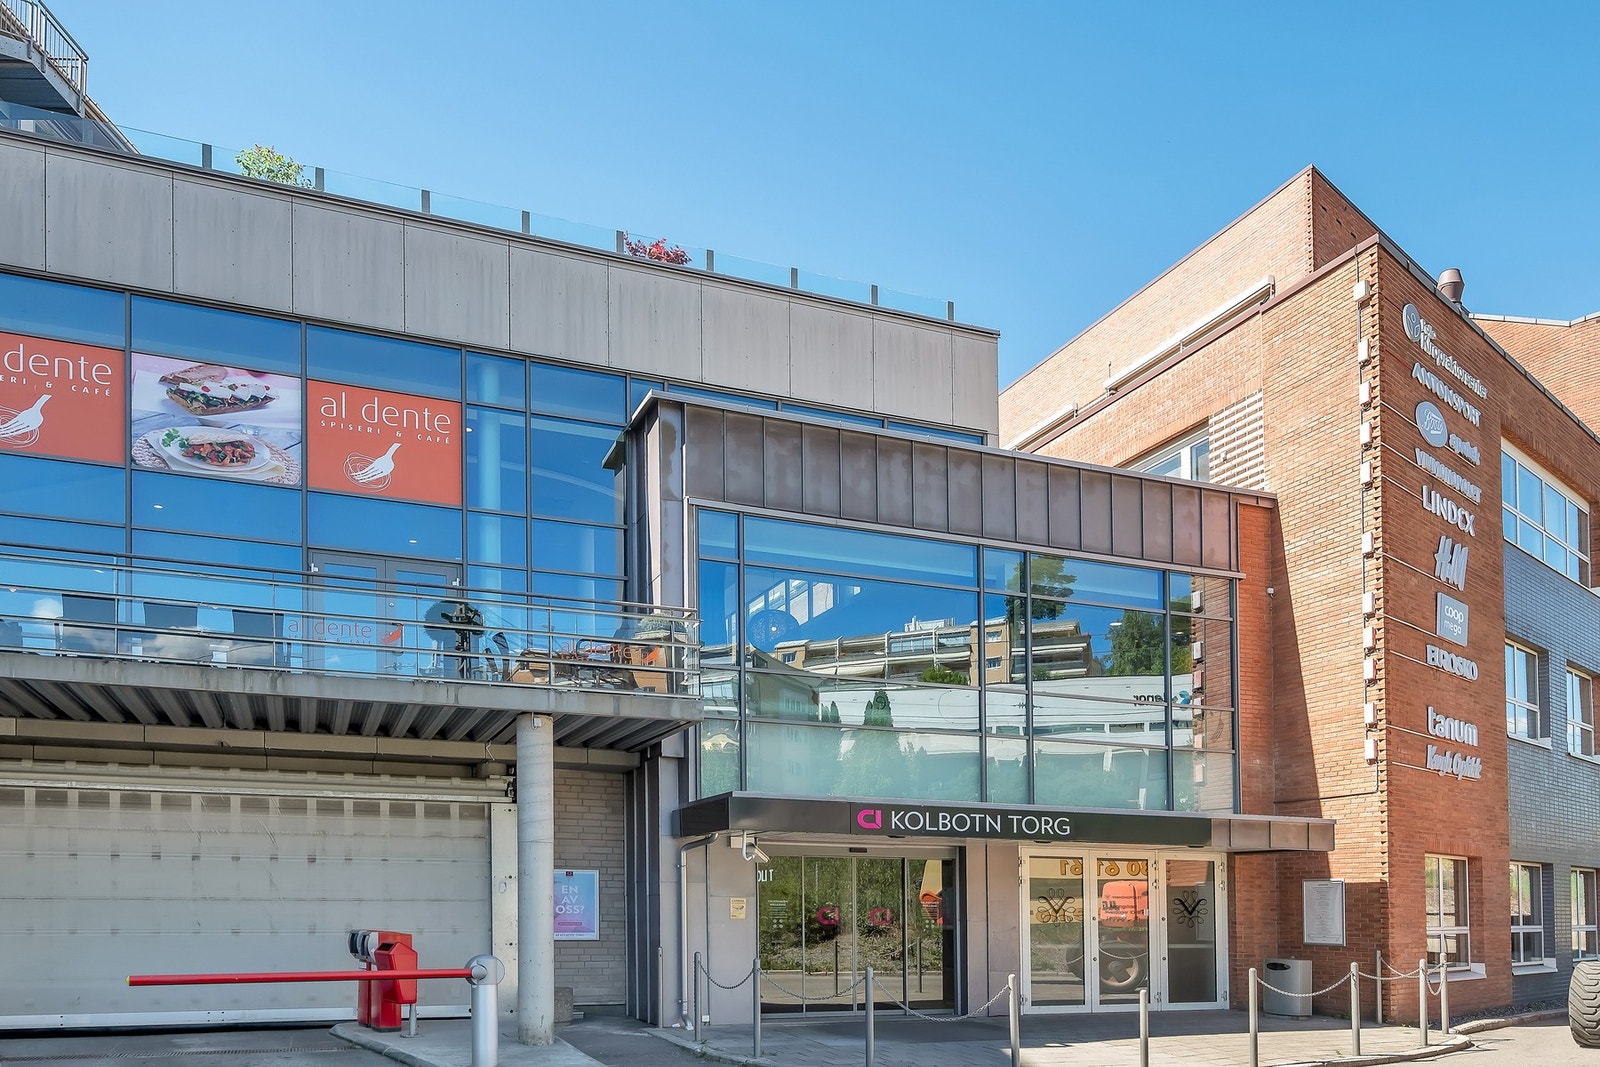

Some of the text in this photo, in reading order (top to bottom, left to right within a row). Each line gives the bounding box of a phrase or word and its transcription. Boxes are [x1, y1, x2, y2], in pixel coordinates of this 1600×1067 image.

[3, 343, 112, 385] dente
[71, 384, 111, 396] CAFÉ
[320, 391, 451, 434] al dente
[320, 419, 450, 445] SPISERI & CAFÉ
[1422, 485, 1476, 537] LINDEX
[1434, 535, 1469, 591] H&M
[288, 615, 305, 634] al
[314, 615, 372, 639] dente
[1444, 605, 1464, 624] coop
[1443, 620, 1462, 636] mega
[1426, 644, 1478, 681] EUROSKO
[1427, 706, 1479, 747] tanum
[891, 810, 1001, 833] KOLBOTN
[1008, 815, 1071, 836] TORG
[561, 885, 578, 894] EN
[561, 895, 578, 904] AV
[555, 905, 585, 914] OSS?
